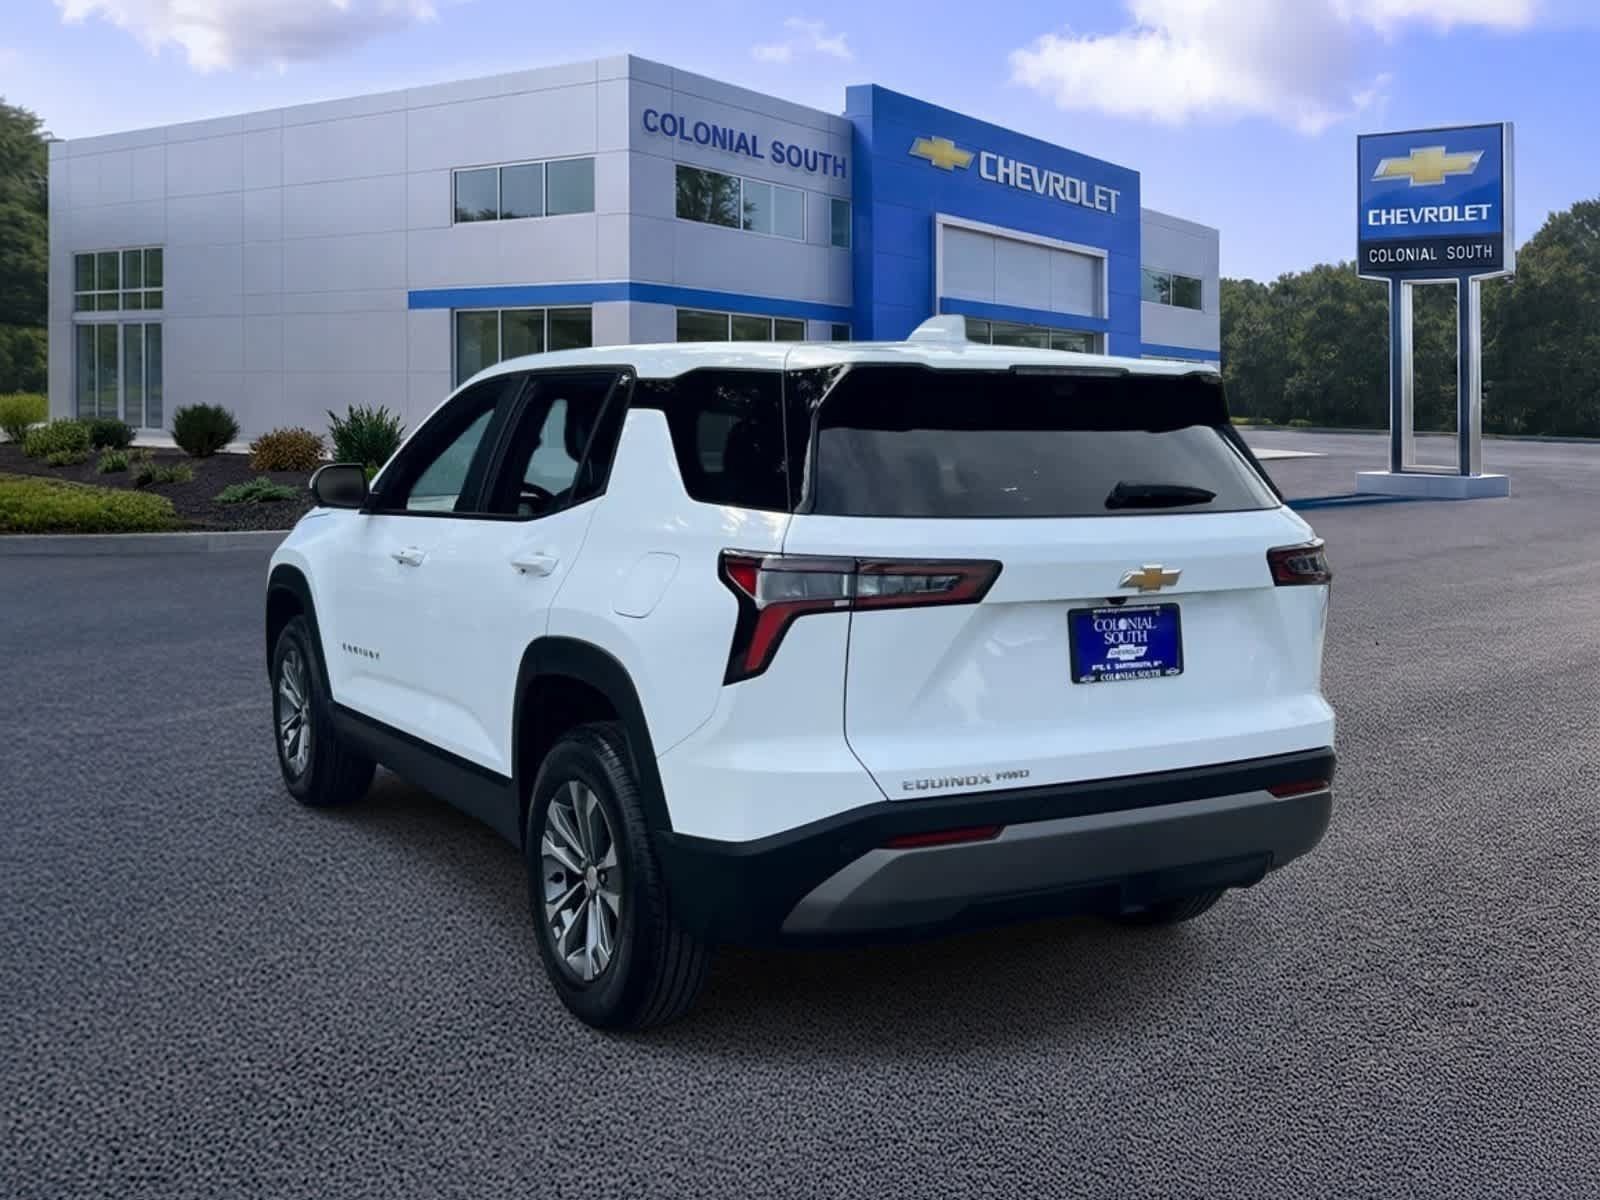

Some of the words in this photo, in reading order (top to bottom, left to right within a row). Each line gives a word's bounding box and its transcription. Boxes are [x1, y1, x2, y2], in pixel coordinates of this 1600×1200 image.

[642, 108, 765, 160] COLONIAL
[771, 140, 847, 179] SOUTH
[979, 150, 1121, 214] CHEVROLET
[1367, 203, 1493, 226] CHEVROLET
[1368, 247, 1438, 263] COLONIAL
[1447, 244, 1493, 260] SOUTH
[1094, 616, 1155, 632] COLONIAL
[1104, 630, 1148, 645] SOUTH
[1100, 671, 1136, 681] COLONIAL
[1136, 668, 1161, 679] SOUTH
[902, 774, 992, 791] EQUINOX
